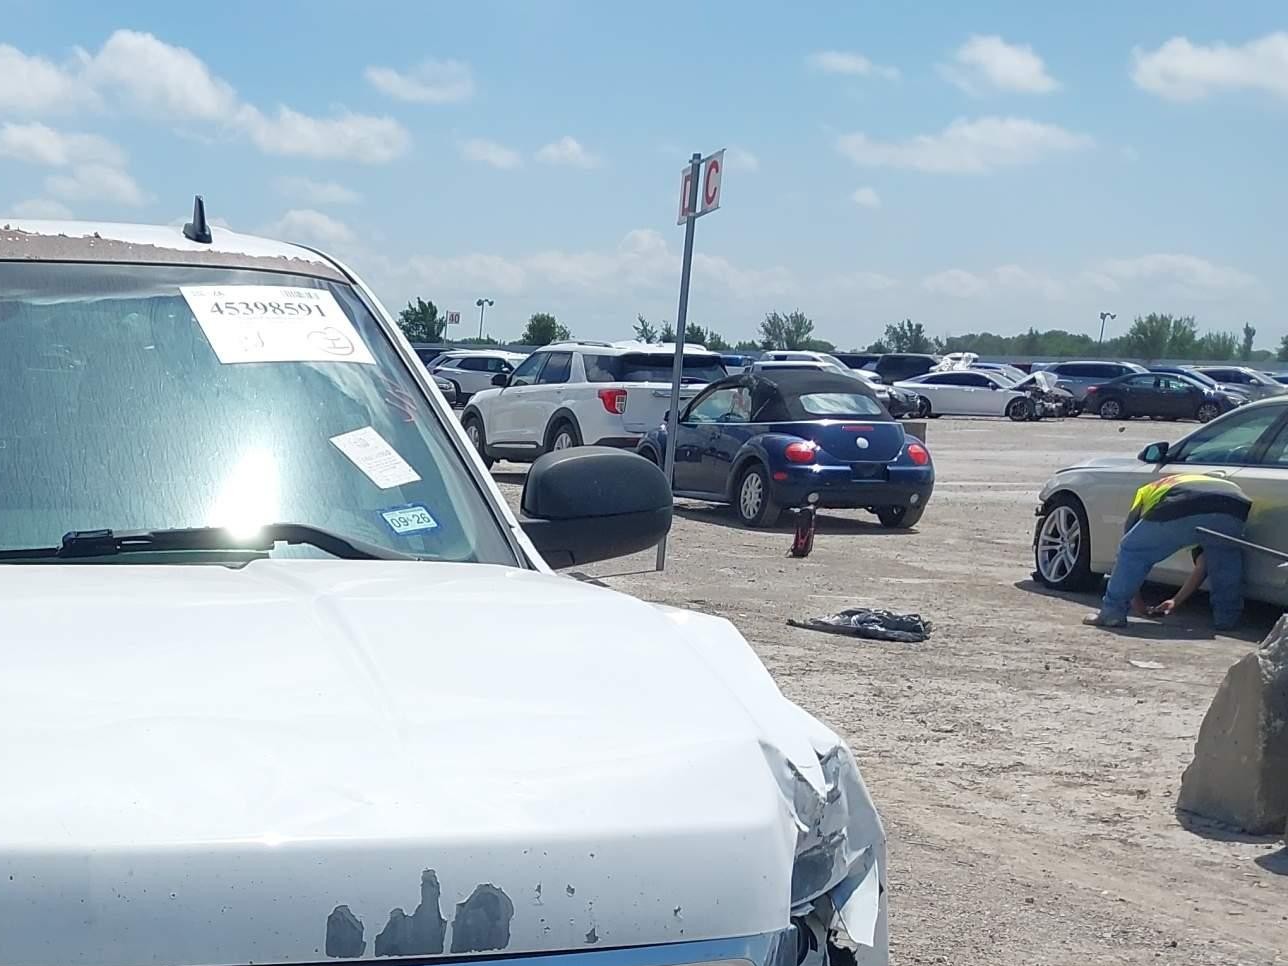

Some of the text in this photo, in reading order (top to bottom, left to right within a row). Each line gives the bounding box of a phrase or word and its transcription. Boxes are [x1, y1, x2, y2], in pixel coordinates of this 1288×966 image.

[210, 301, 327, 318] 45398591
[449, 313, 460, 324] 40
[390, 512, 431, 528] 09 26
